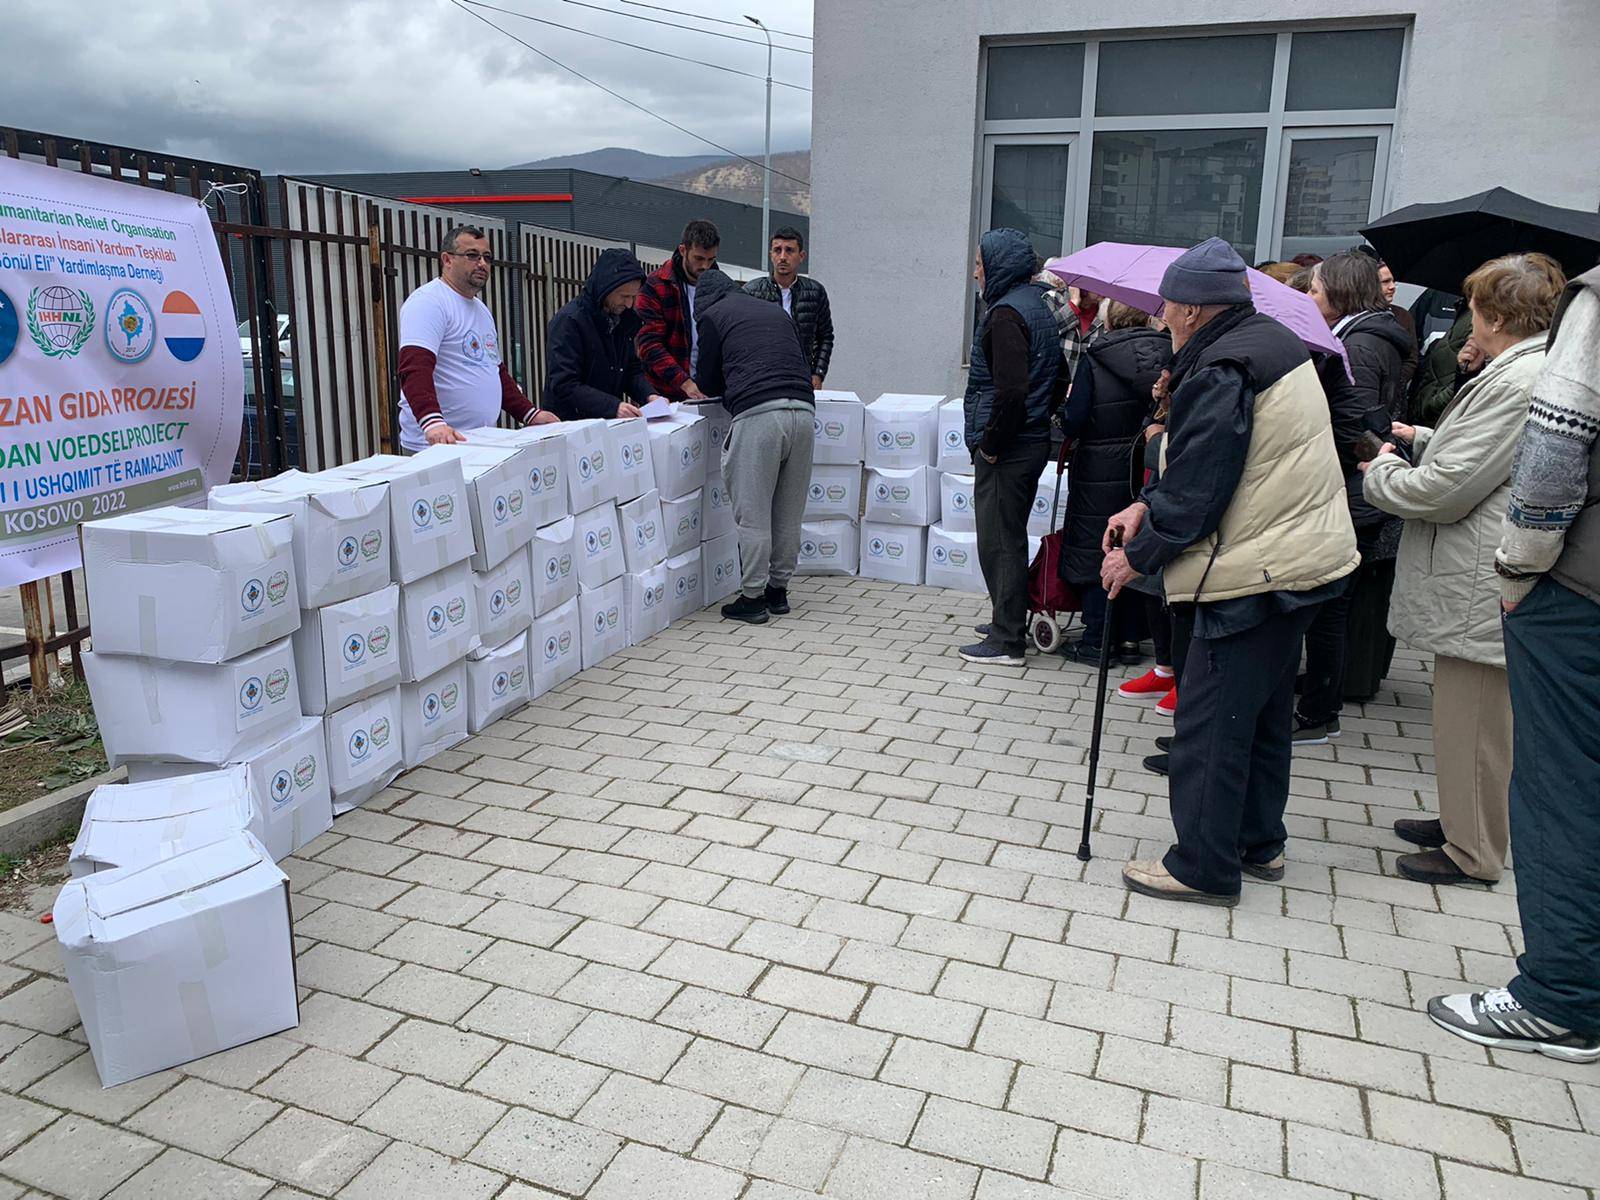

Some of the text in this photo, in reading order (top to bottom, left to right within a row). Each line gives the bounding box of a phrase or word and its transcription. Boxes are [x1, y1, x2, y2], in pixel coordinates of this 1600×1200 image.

[0, 227, 177, 263] lararası İnsani Yardım Teşkilatı
[74, 213, 109, 231] Relief
[111, 218, 177, 241] Organisation
[0, 252, 32, 271] önül
[127, 263, 164, 284] Derneği
[39, 311, 83, 323] IHHNL
[59, 389, 112, 421] GIDA
[111, 380, 196, 414] PROJESİ
[46, 422, 190, 463] VOEDSELPROJECT
[13, 481, 19, 502] I
[25, 466, 102, 500] USHQIMIT
[105, 459, 122, 484] TË
[125, 448, 184, 481] RAMAZANIT
[5, 490, 127, 535] KOSOVO 2022
